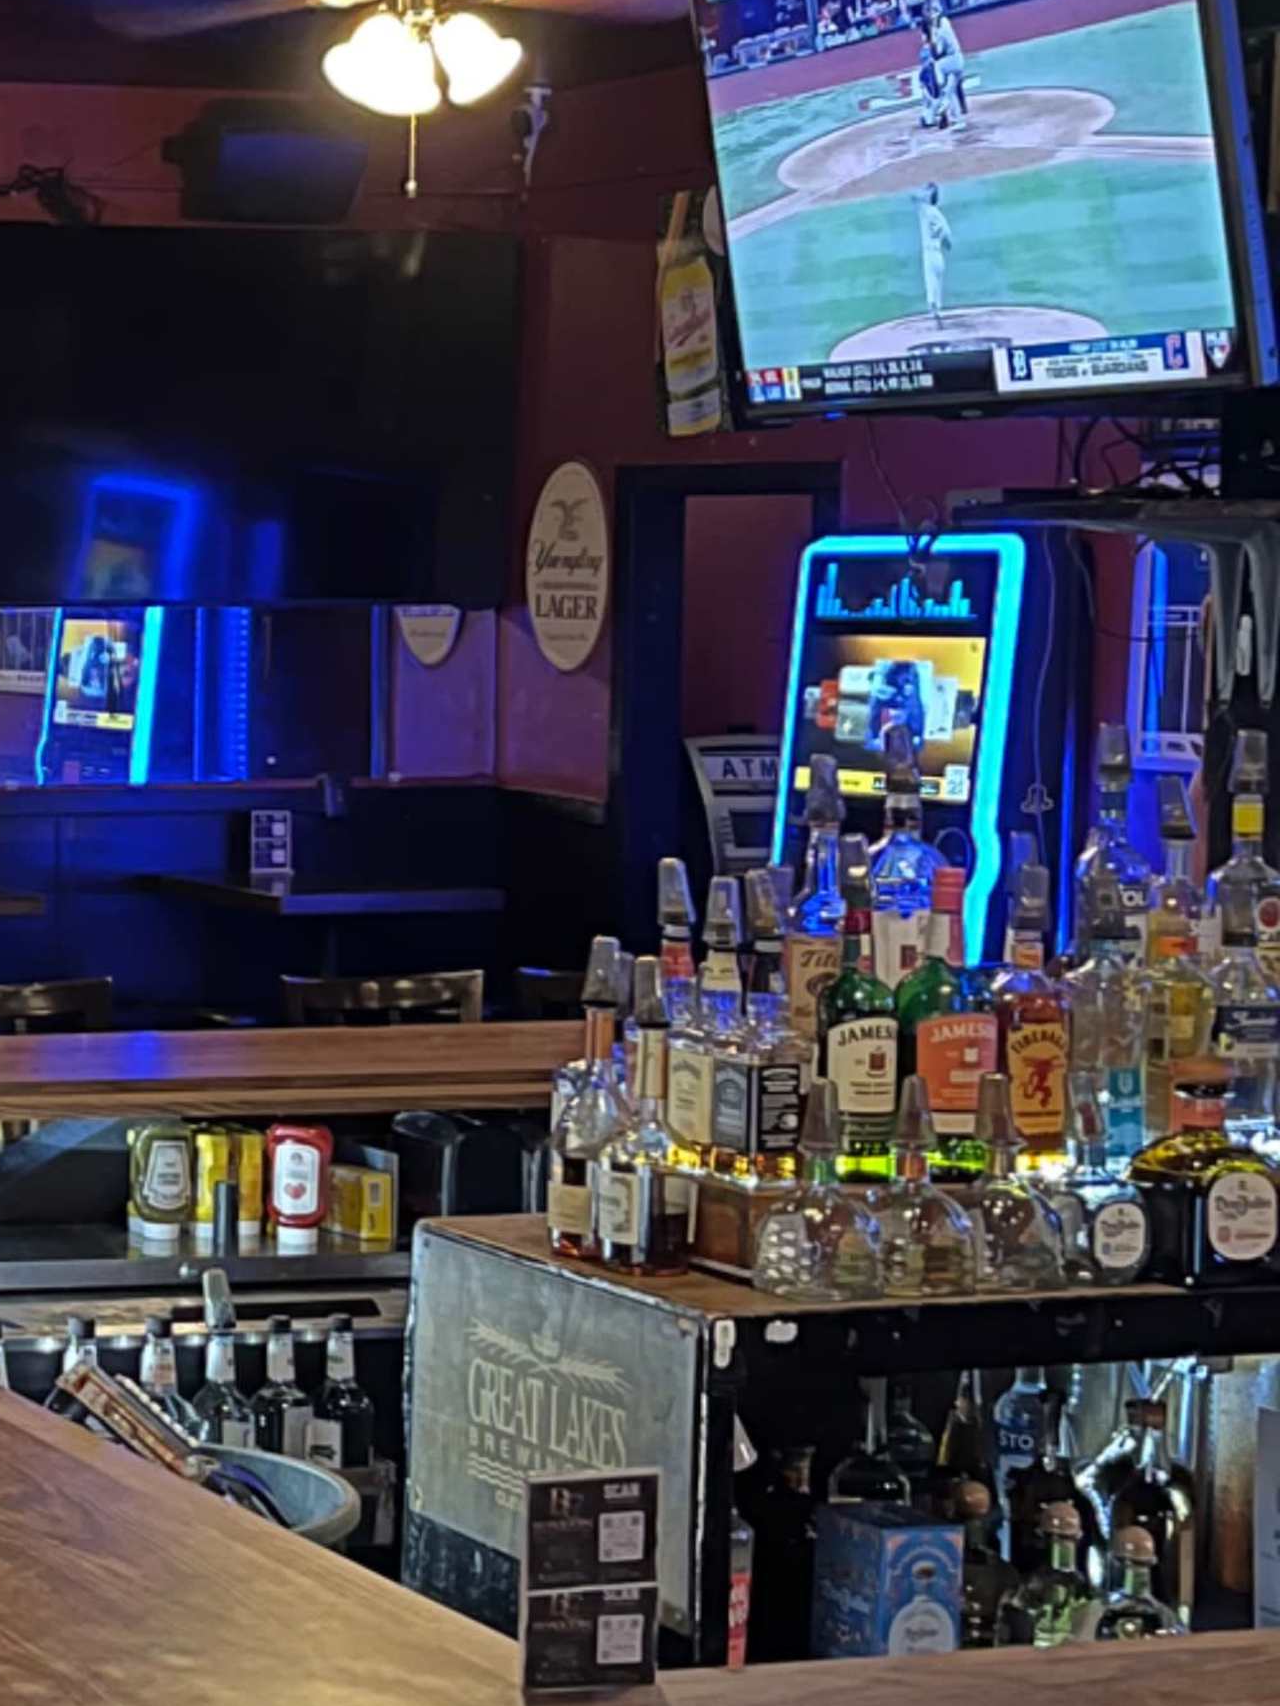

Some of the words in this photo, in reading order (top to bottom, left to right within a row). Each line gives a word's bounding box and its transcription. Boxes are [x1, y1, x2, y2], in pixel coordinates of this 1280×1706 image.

[535, 593, 598, 620] LAGER
[721, 757, 779, 781] ATM
[467, 1356, 544, 1445] GREAT
[549, 1384, 628, 1473] LAKES
